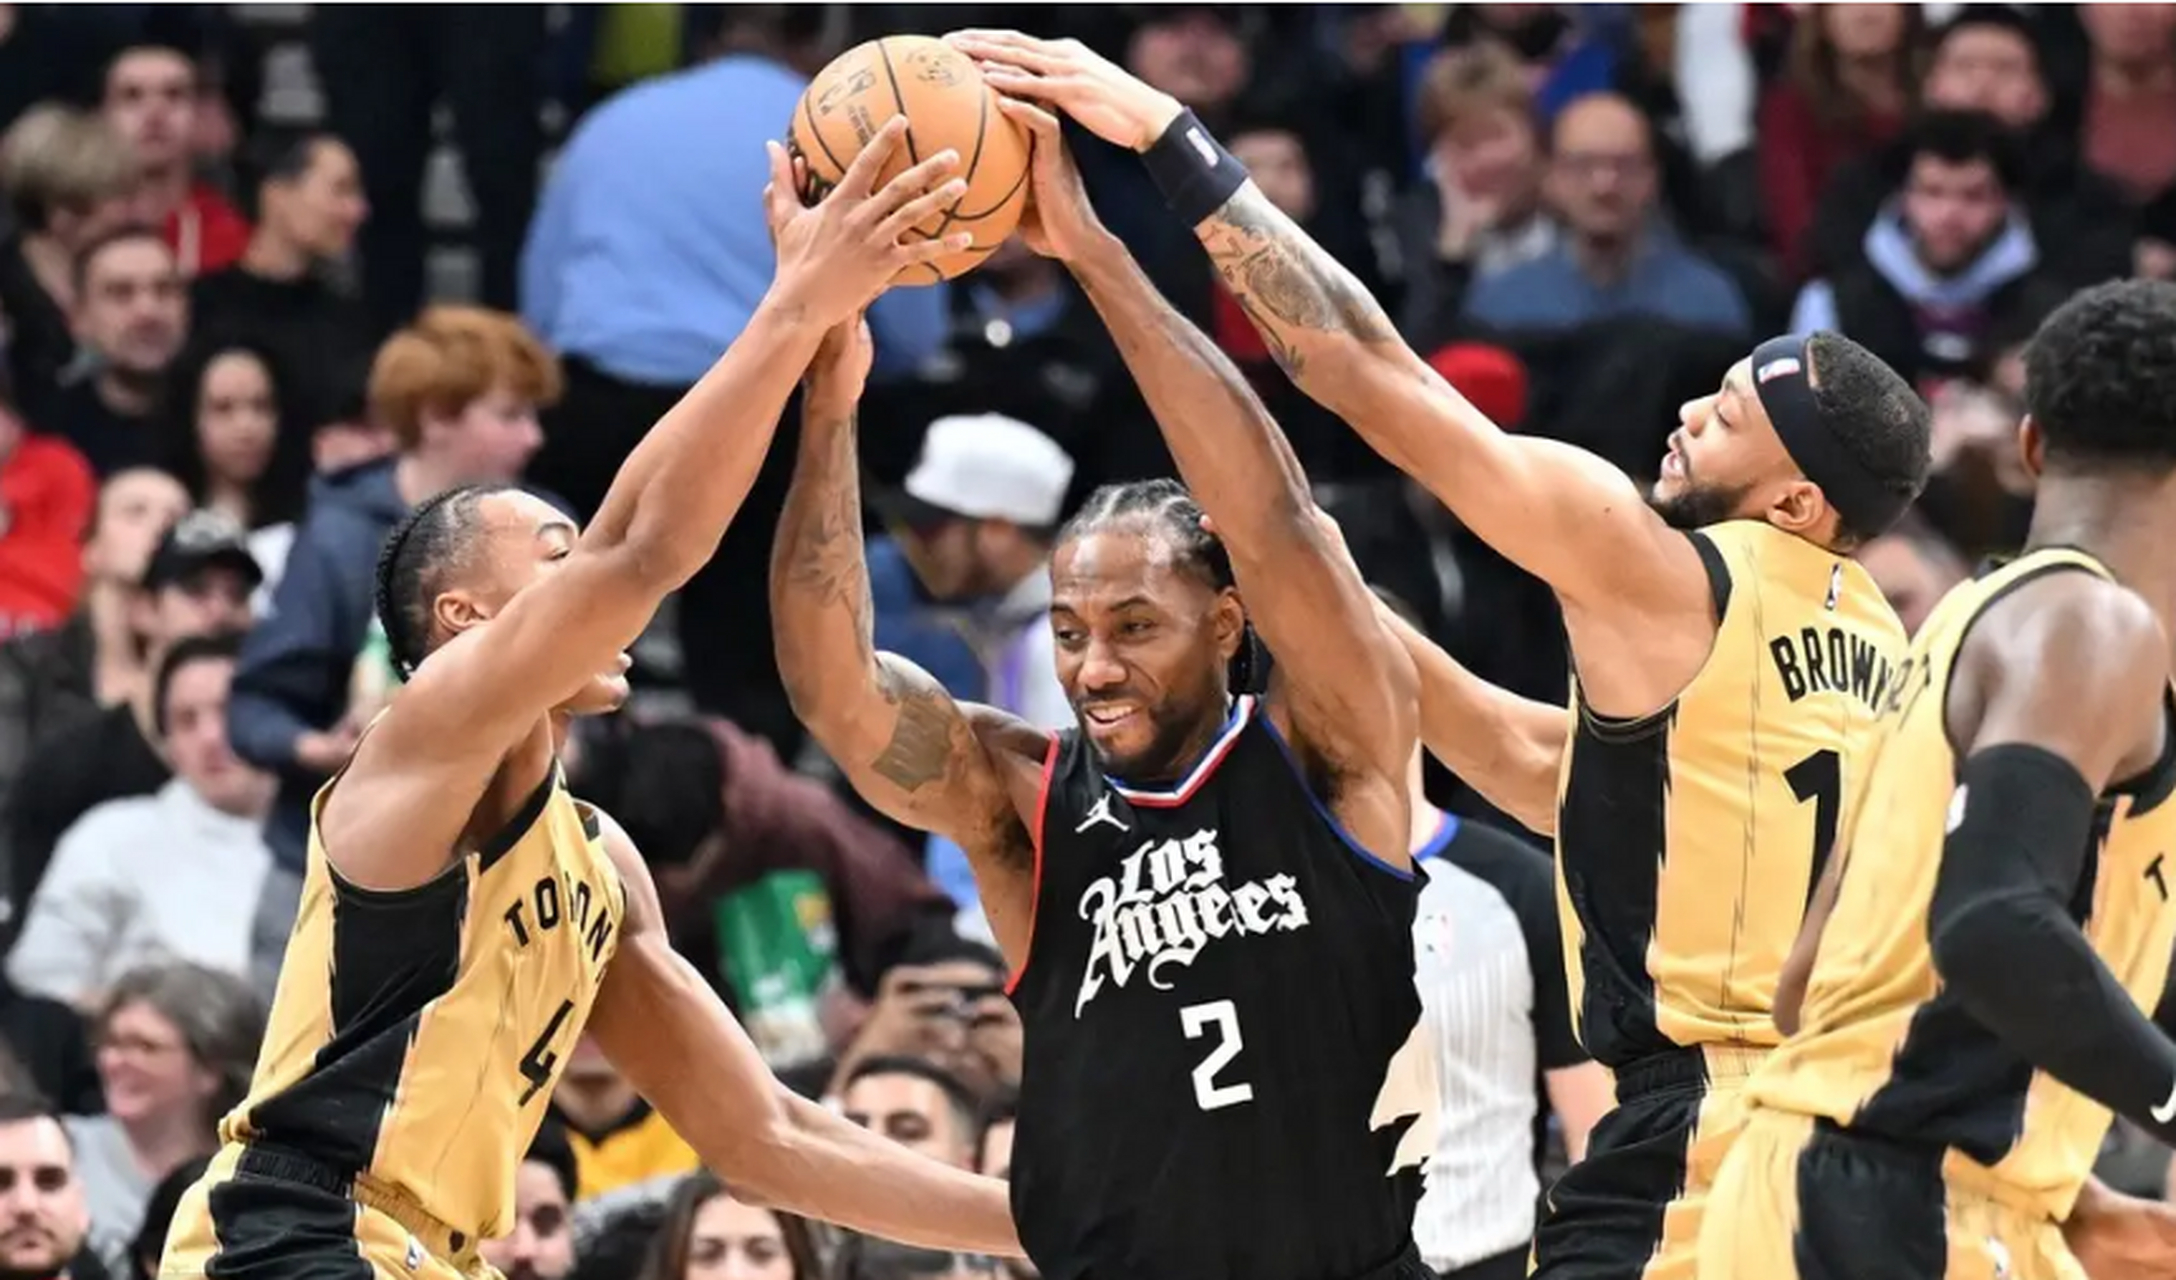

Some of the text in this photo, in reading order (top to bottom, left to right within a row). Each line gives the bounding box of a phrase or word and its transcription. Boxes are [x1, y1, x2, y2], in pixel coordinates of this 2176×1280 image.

[1115, 828, 1224, 905] Los
[504, 870, 613, 983] TOON
[518, 998, 575, 1107] 4
[1179, 999, 1254, 1111] 2
